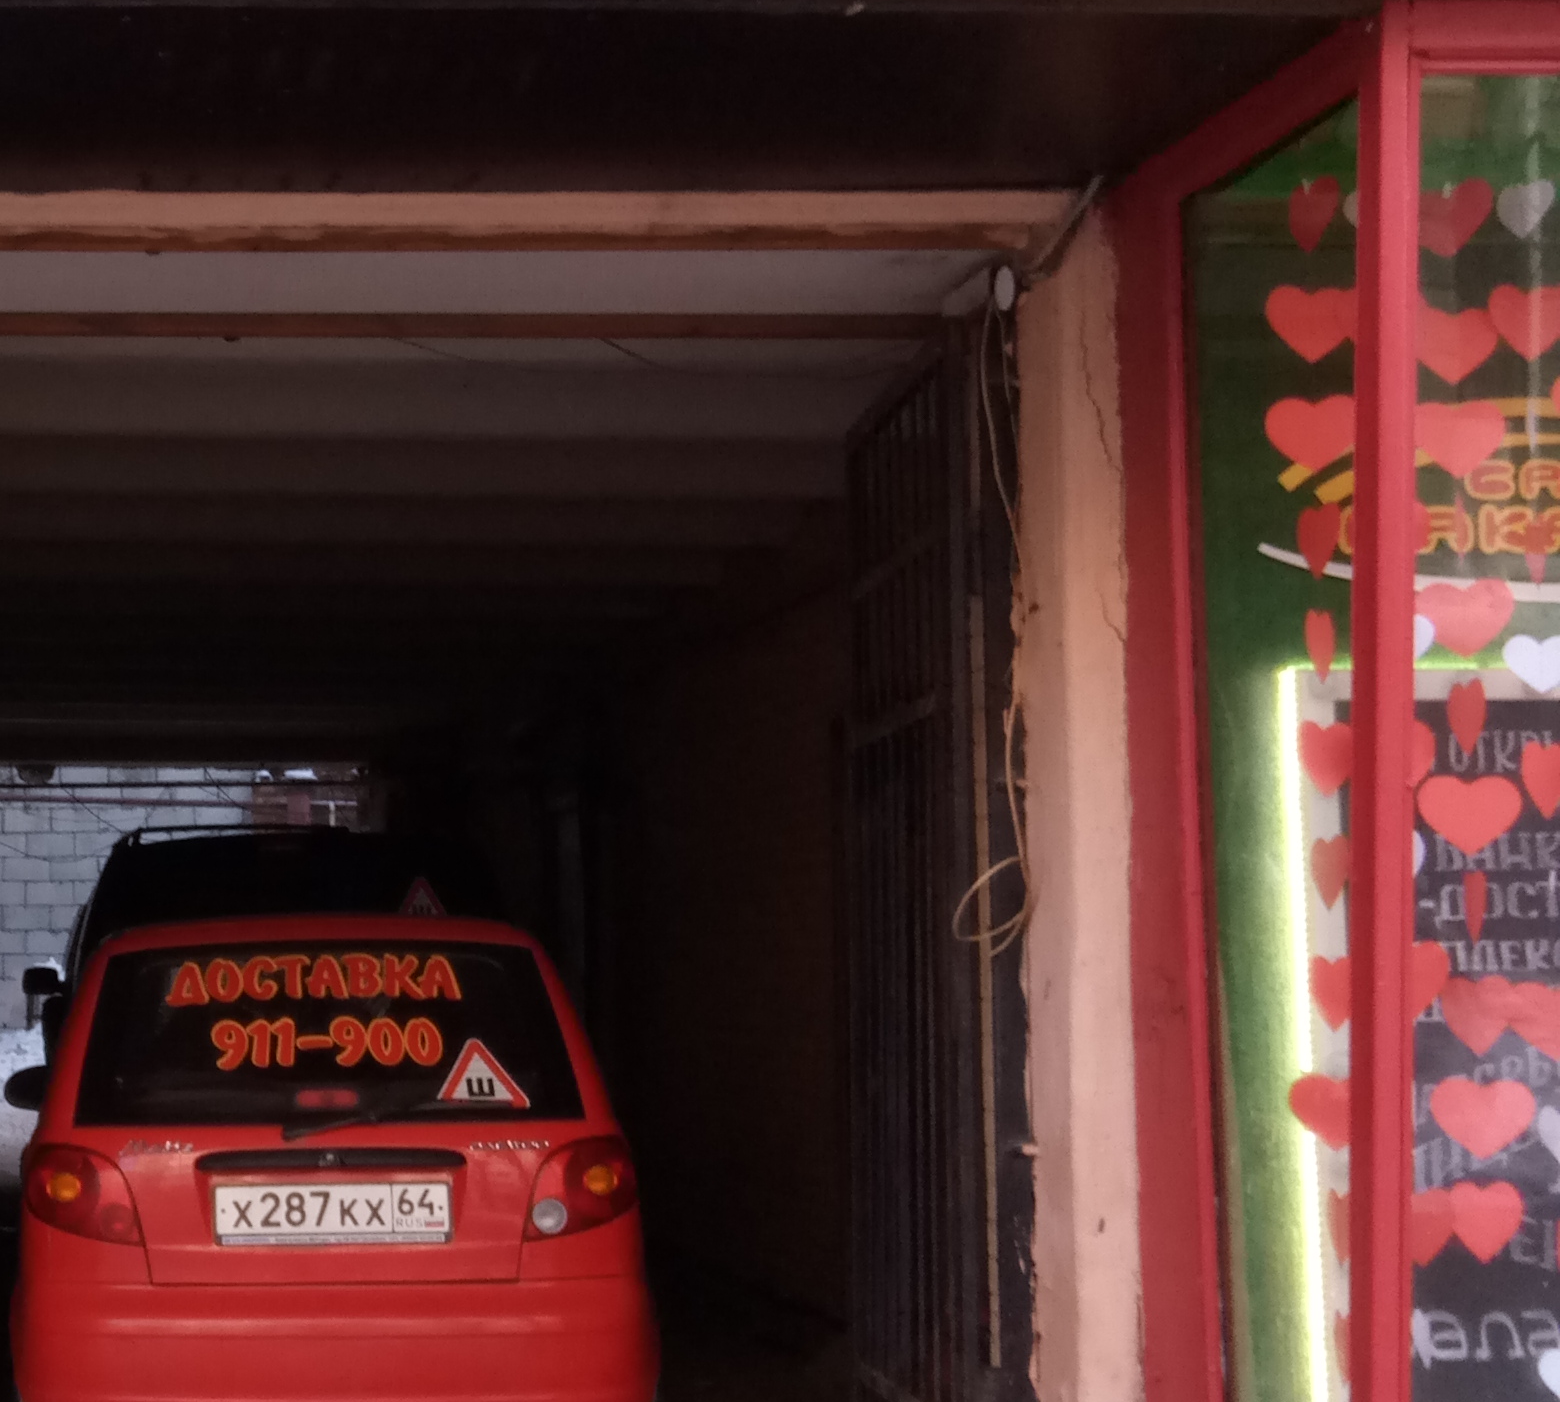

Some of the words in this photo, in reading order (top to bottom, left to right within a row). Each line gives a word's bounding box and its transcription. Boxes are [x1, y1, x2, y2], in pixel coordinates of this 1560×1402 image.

[166, 953, 462, 1007] ДОСТАВКА
[210, 1015, 444, 1071] 911-900
[465, 1077, 496, 1099] Ш
[397, 1189, 436, 1217] 64
[395, 1217, 425, 1228] RUS
